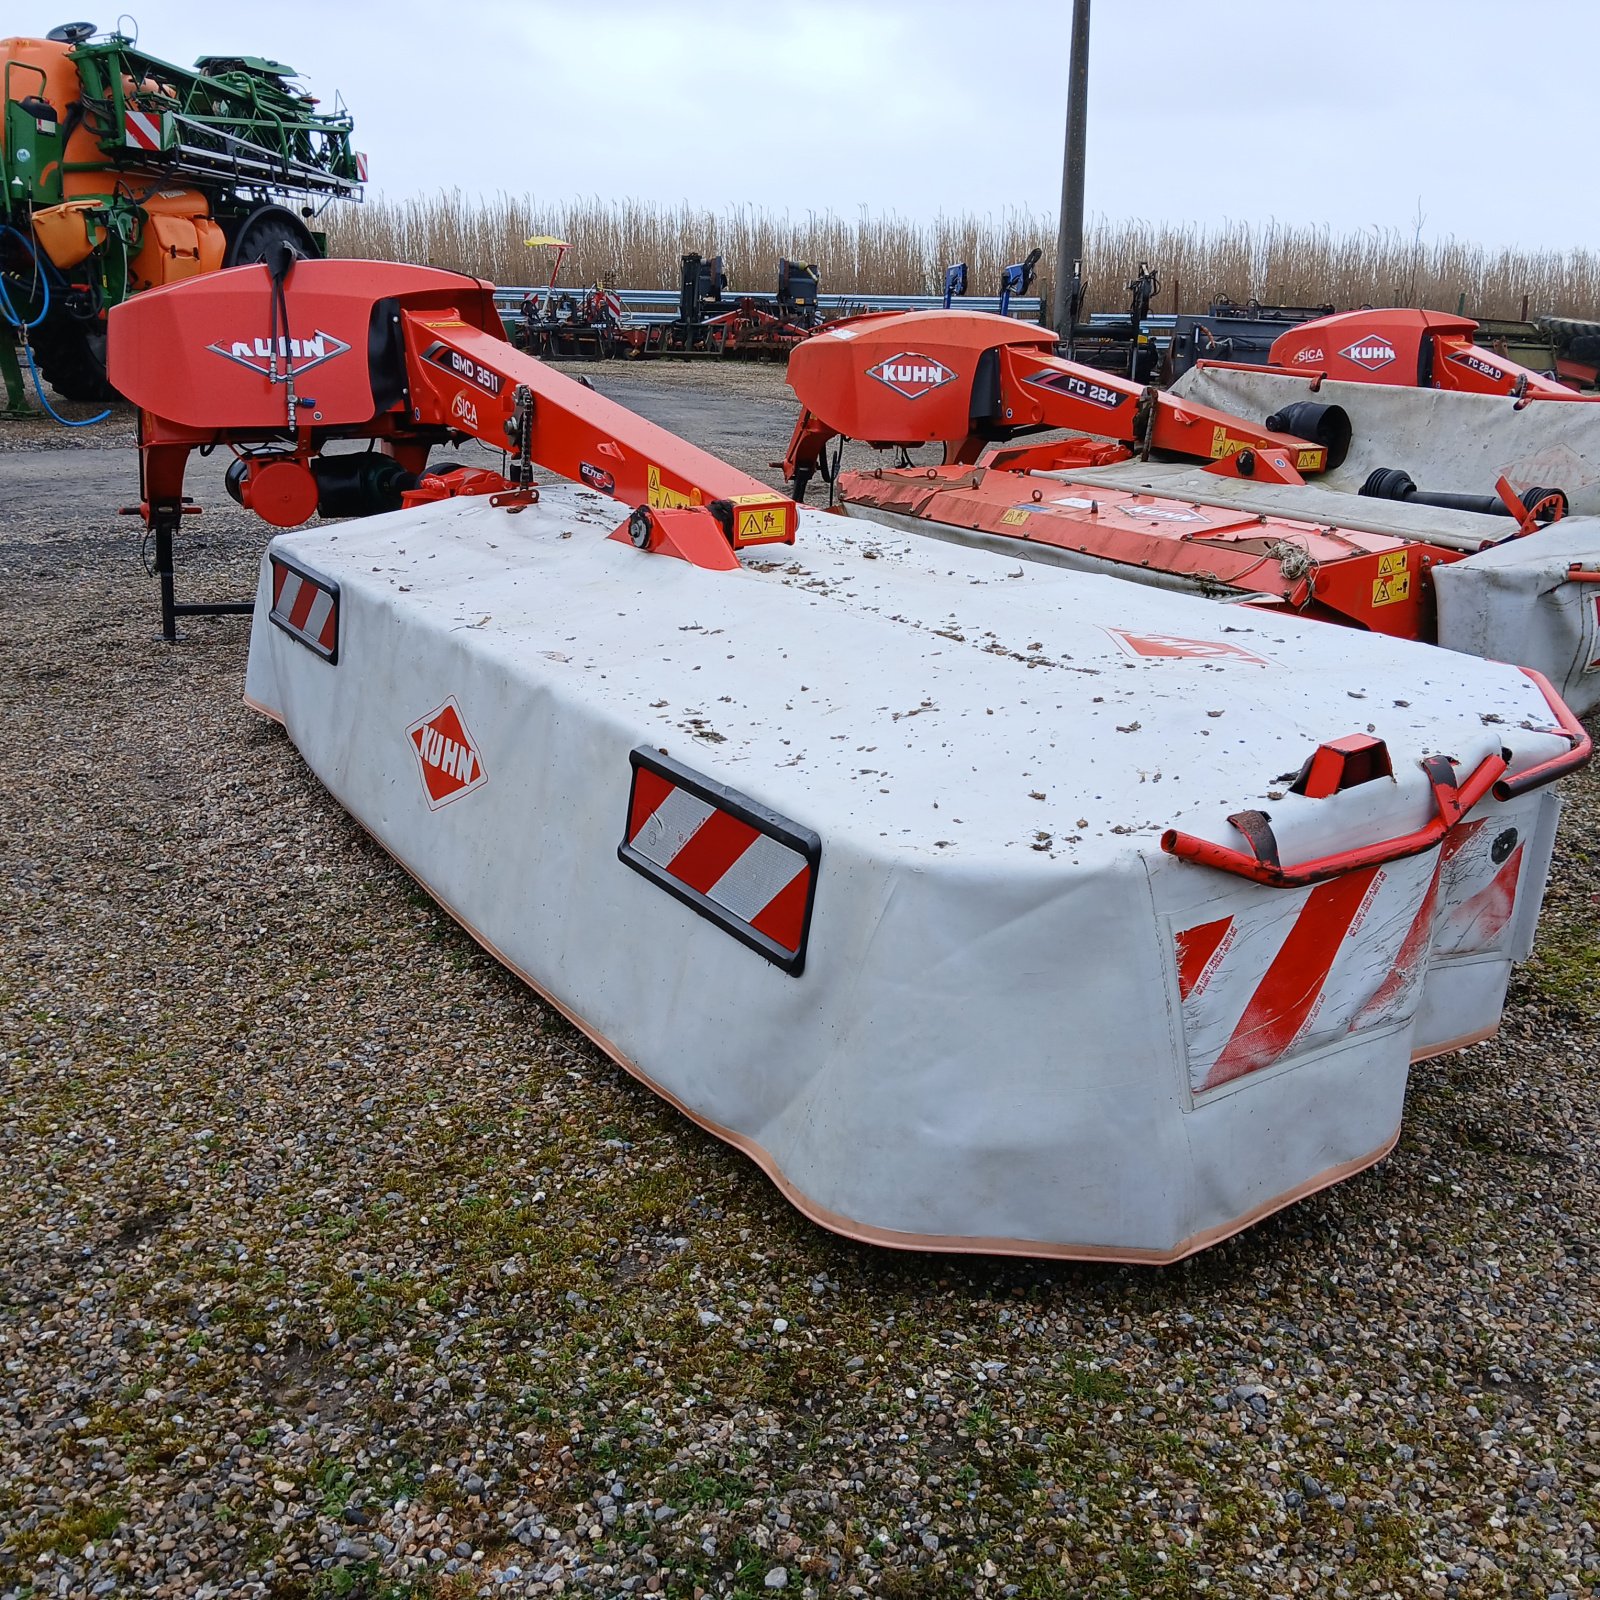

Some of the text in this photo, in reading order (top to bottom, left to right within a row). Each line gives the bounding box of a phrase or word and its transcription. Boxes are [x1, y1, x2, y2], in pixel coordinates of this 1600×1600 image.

[1298, 348, 1324, 361] SICA
[1468, 357, 1502, 379] FC 284 D
[452, 352, 498, 393] GMD 3511
[882, 364, 942, 382] KUHN
[1068, 378, 1117, 405] FC 284
[456, 396, 478, 424] SICA
[419, 724, 476, 786] KUHN
